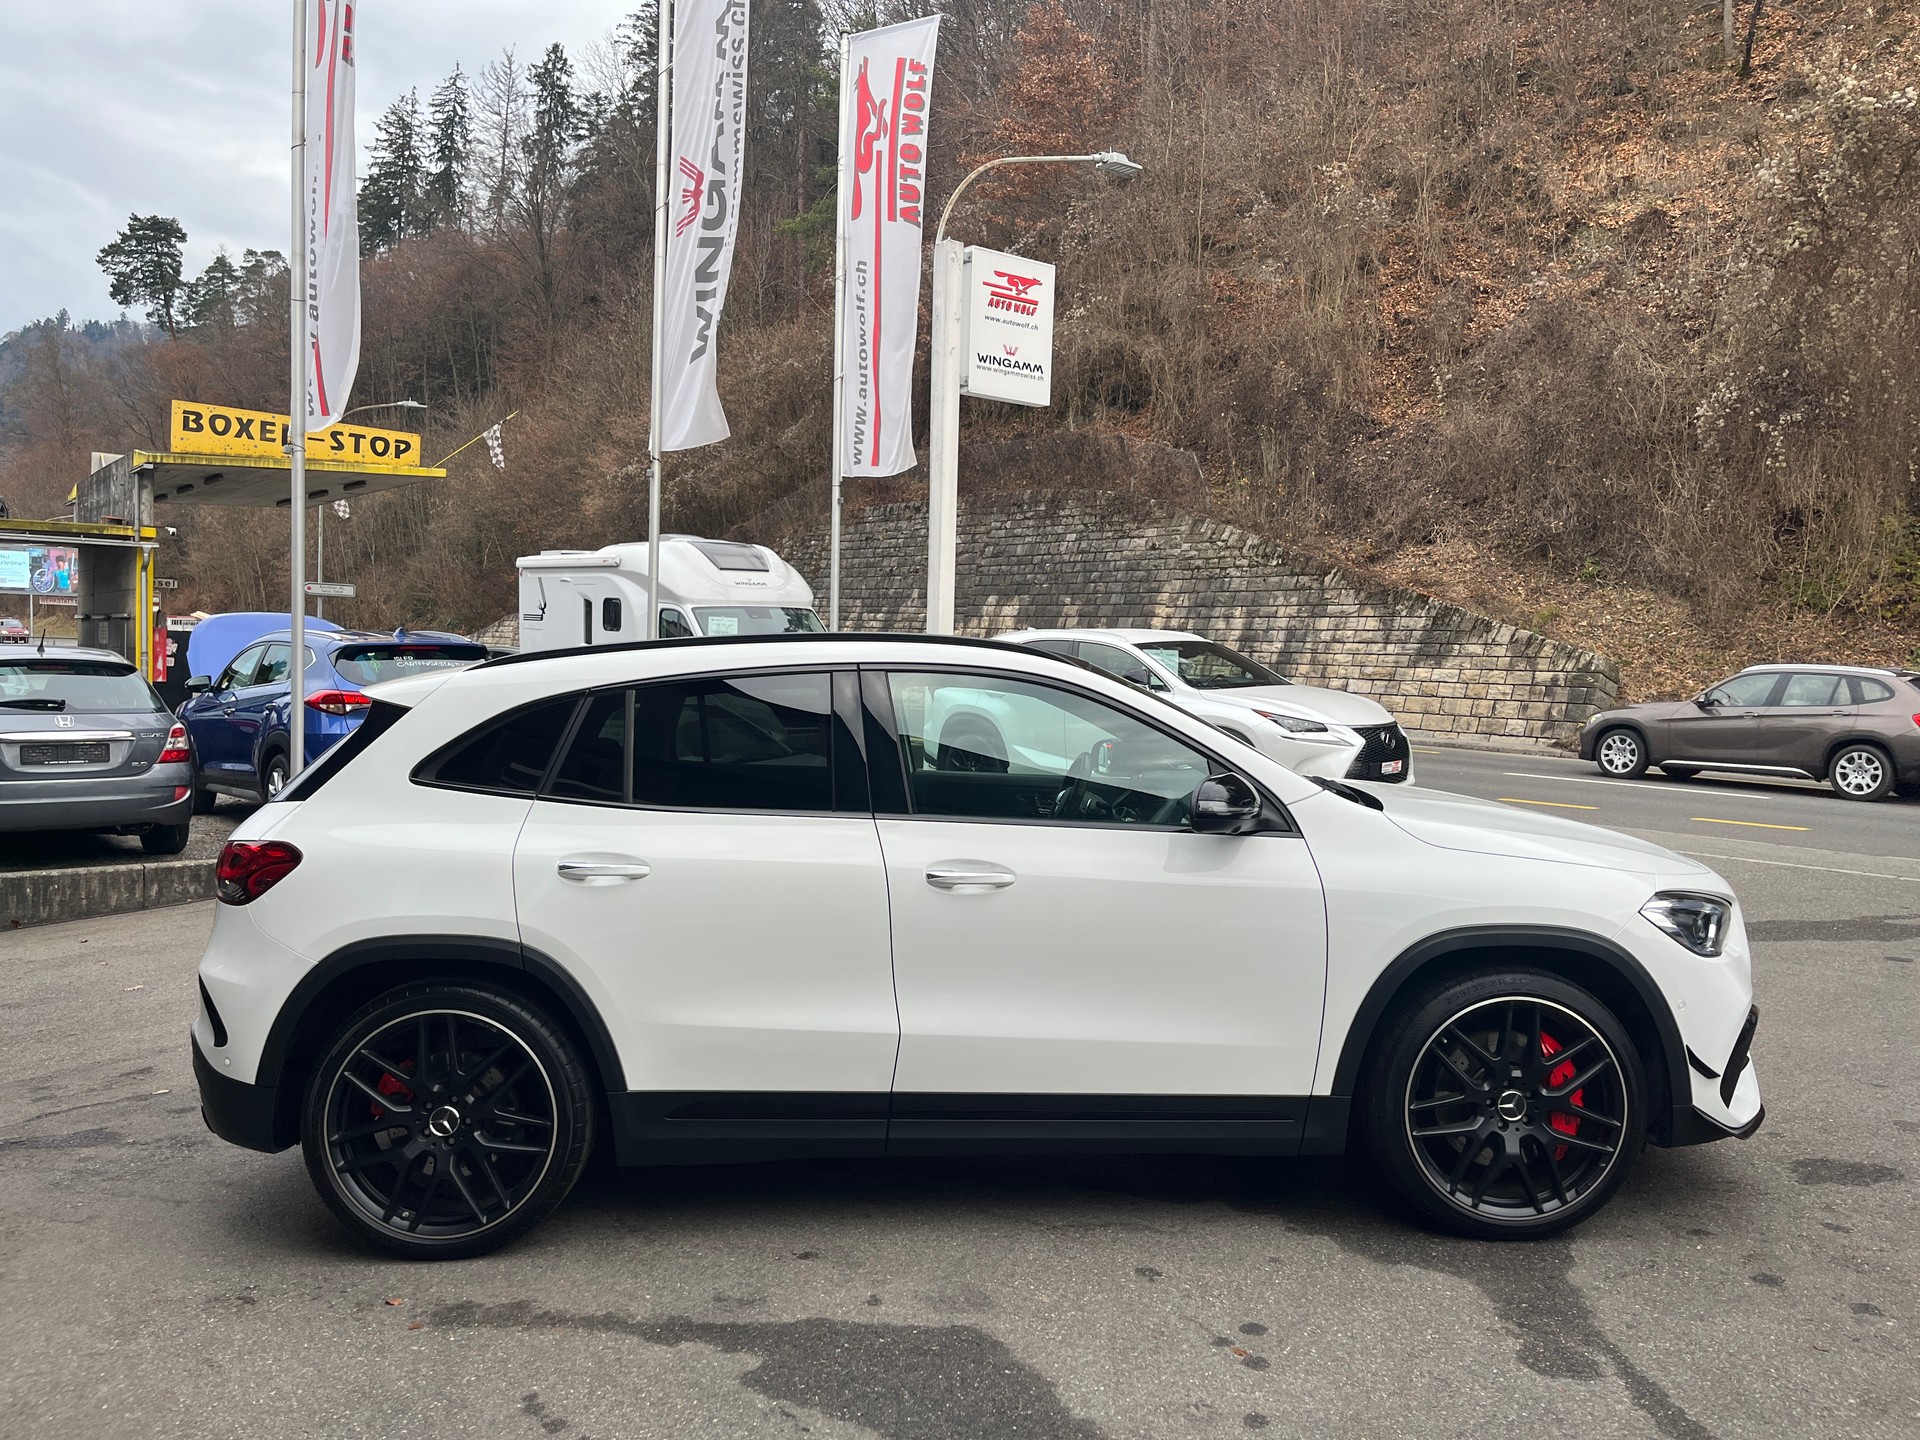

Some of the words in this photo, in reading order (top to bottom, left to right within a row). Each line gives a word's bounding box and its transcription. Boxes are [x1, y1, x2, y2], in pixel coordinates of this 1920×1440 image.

[901, 58, 928, 136] WOLF
[899, 143, 922, 229] AUTO
[987, 297, 1012, 312] AUTO
[1013, 303, 1037, 316] WOLF
[984, 315, 1039, 330] www.autowolf.ch
[853, 260, 868, 466] www.autowolf.ch
[976, 364, 1045, 381] www.wingammswiss.ch
[977, 352, 1044, 374] WINGAMM
[153, 580, 175, 588] sel
